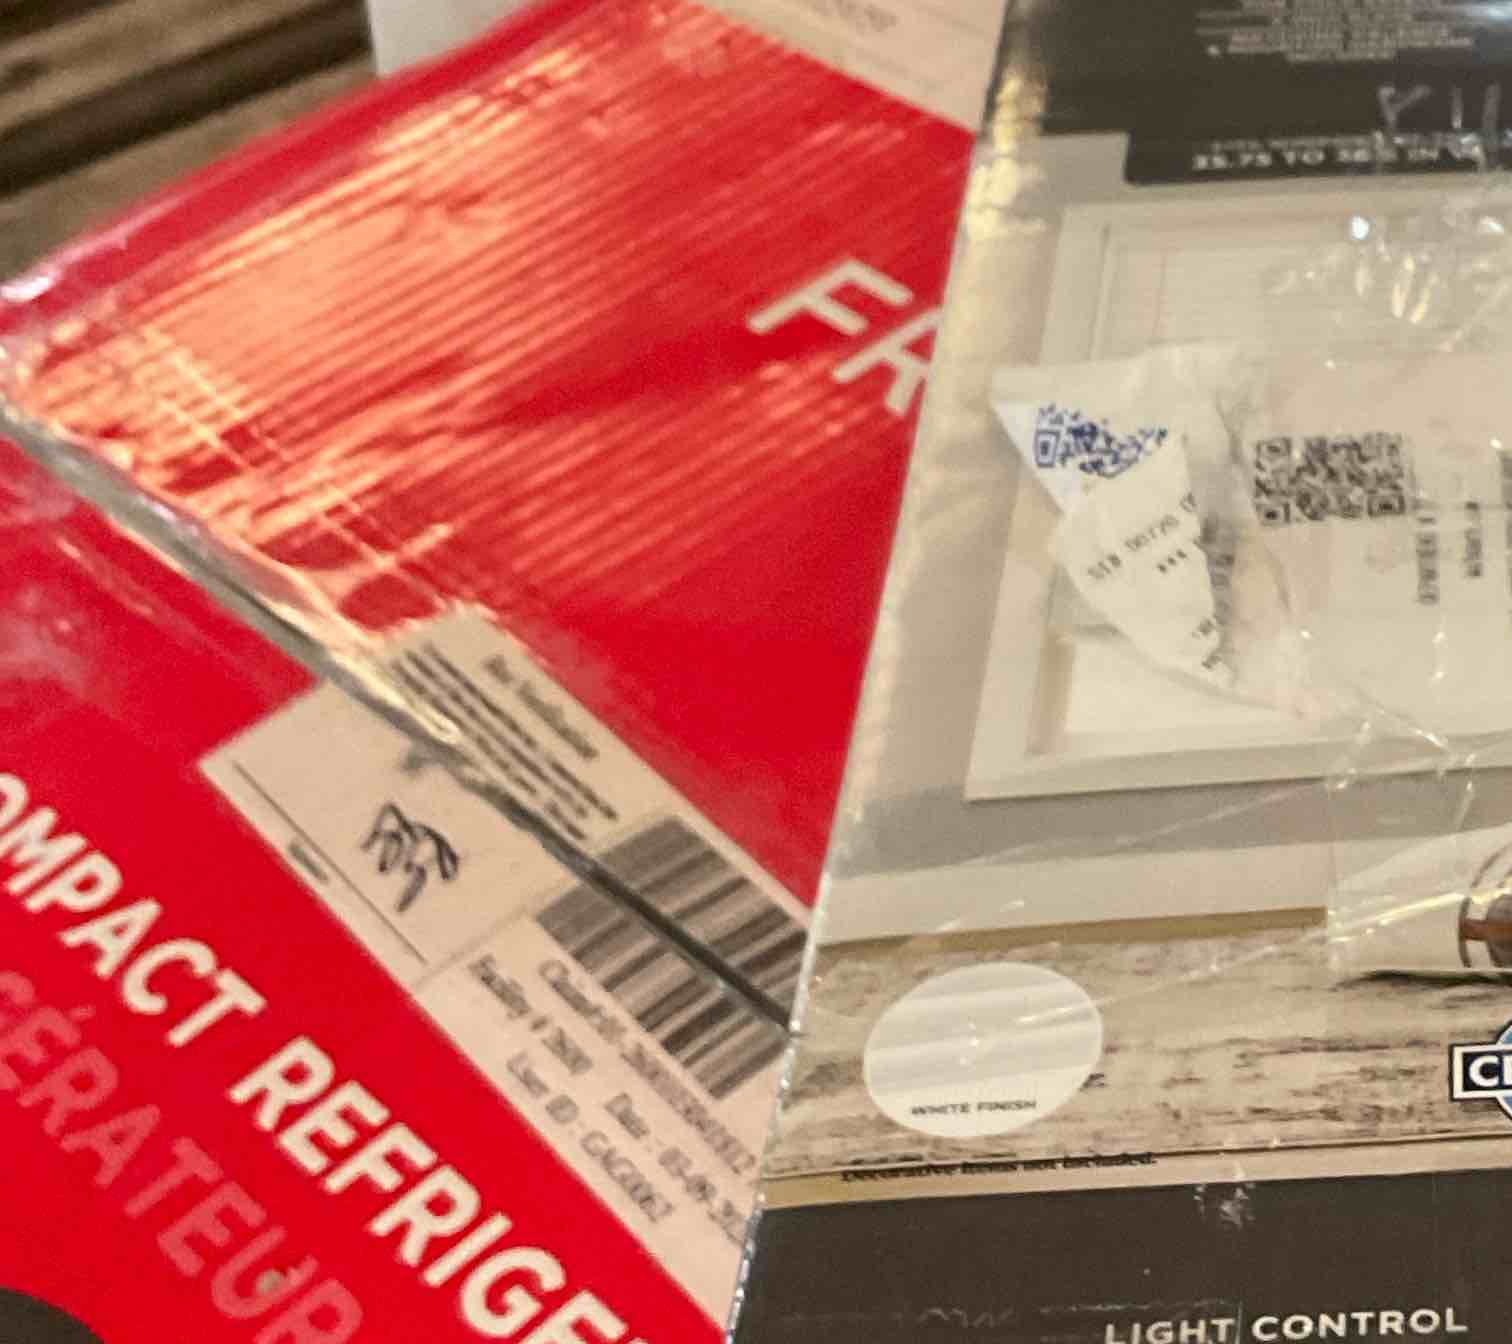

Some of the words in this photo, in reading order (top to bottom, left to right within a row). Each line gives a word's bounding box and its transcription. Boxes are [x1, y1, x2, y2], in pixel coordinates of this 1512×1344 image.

[911, 1102, 969, 1116] WHITE
[976, 1099, 1037, 1113] FINISH
[1251, 1307, 1469, 1344] CONTROL
